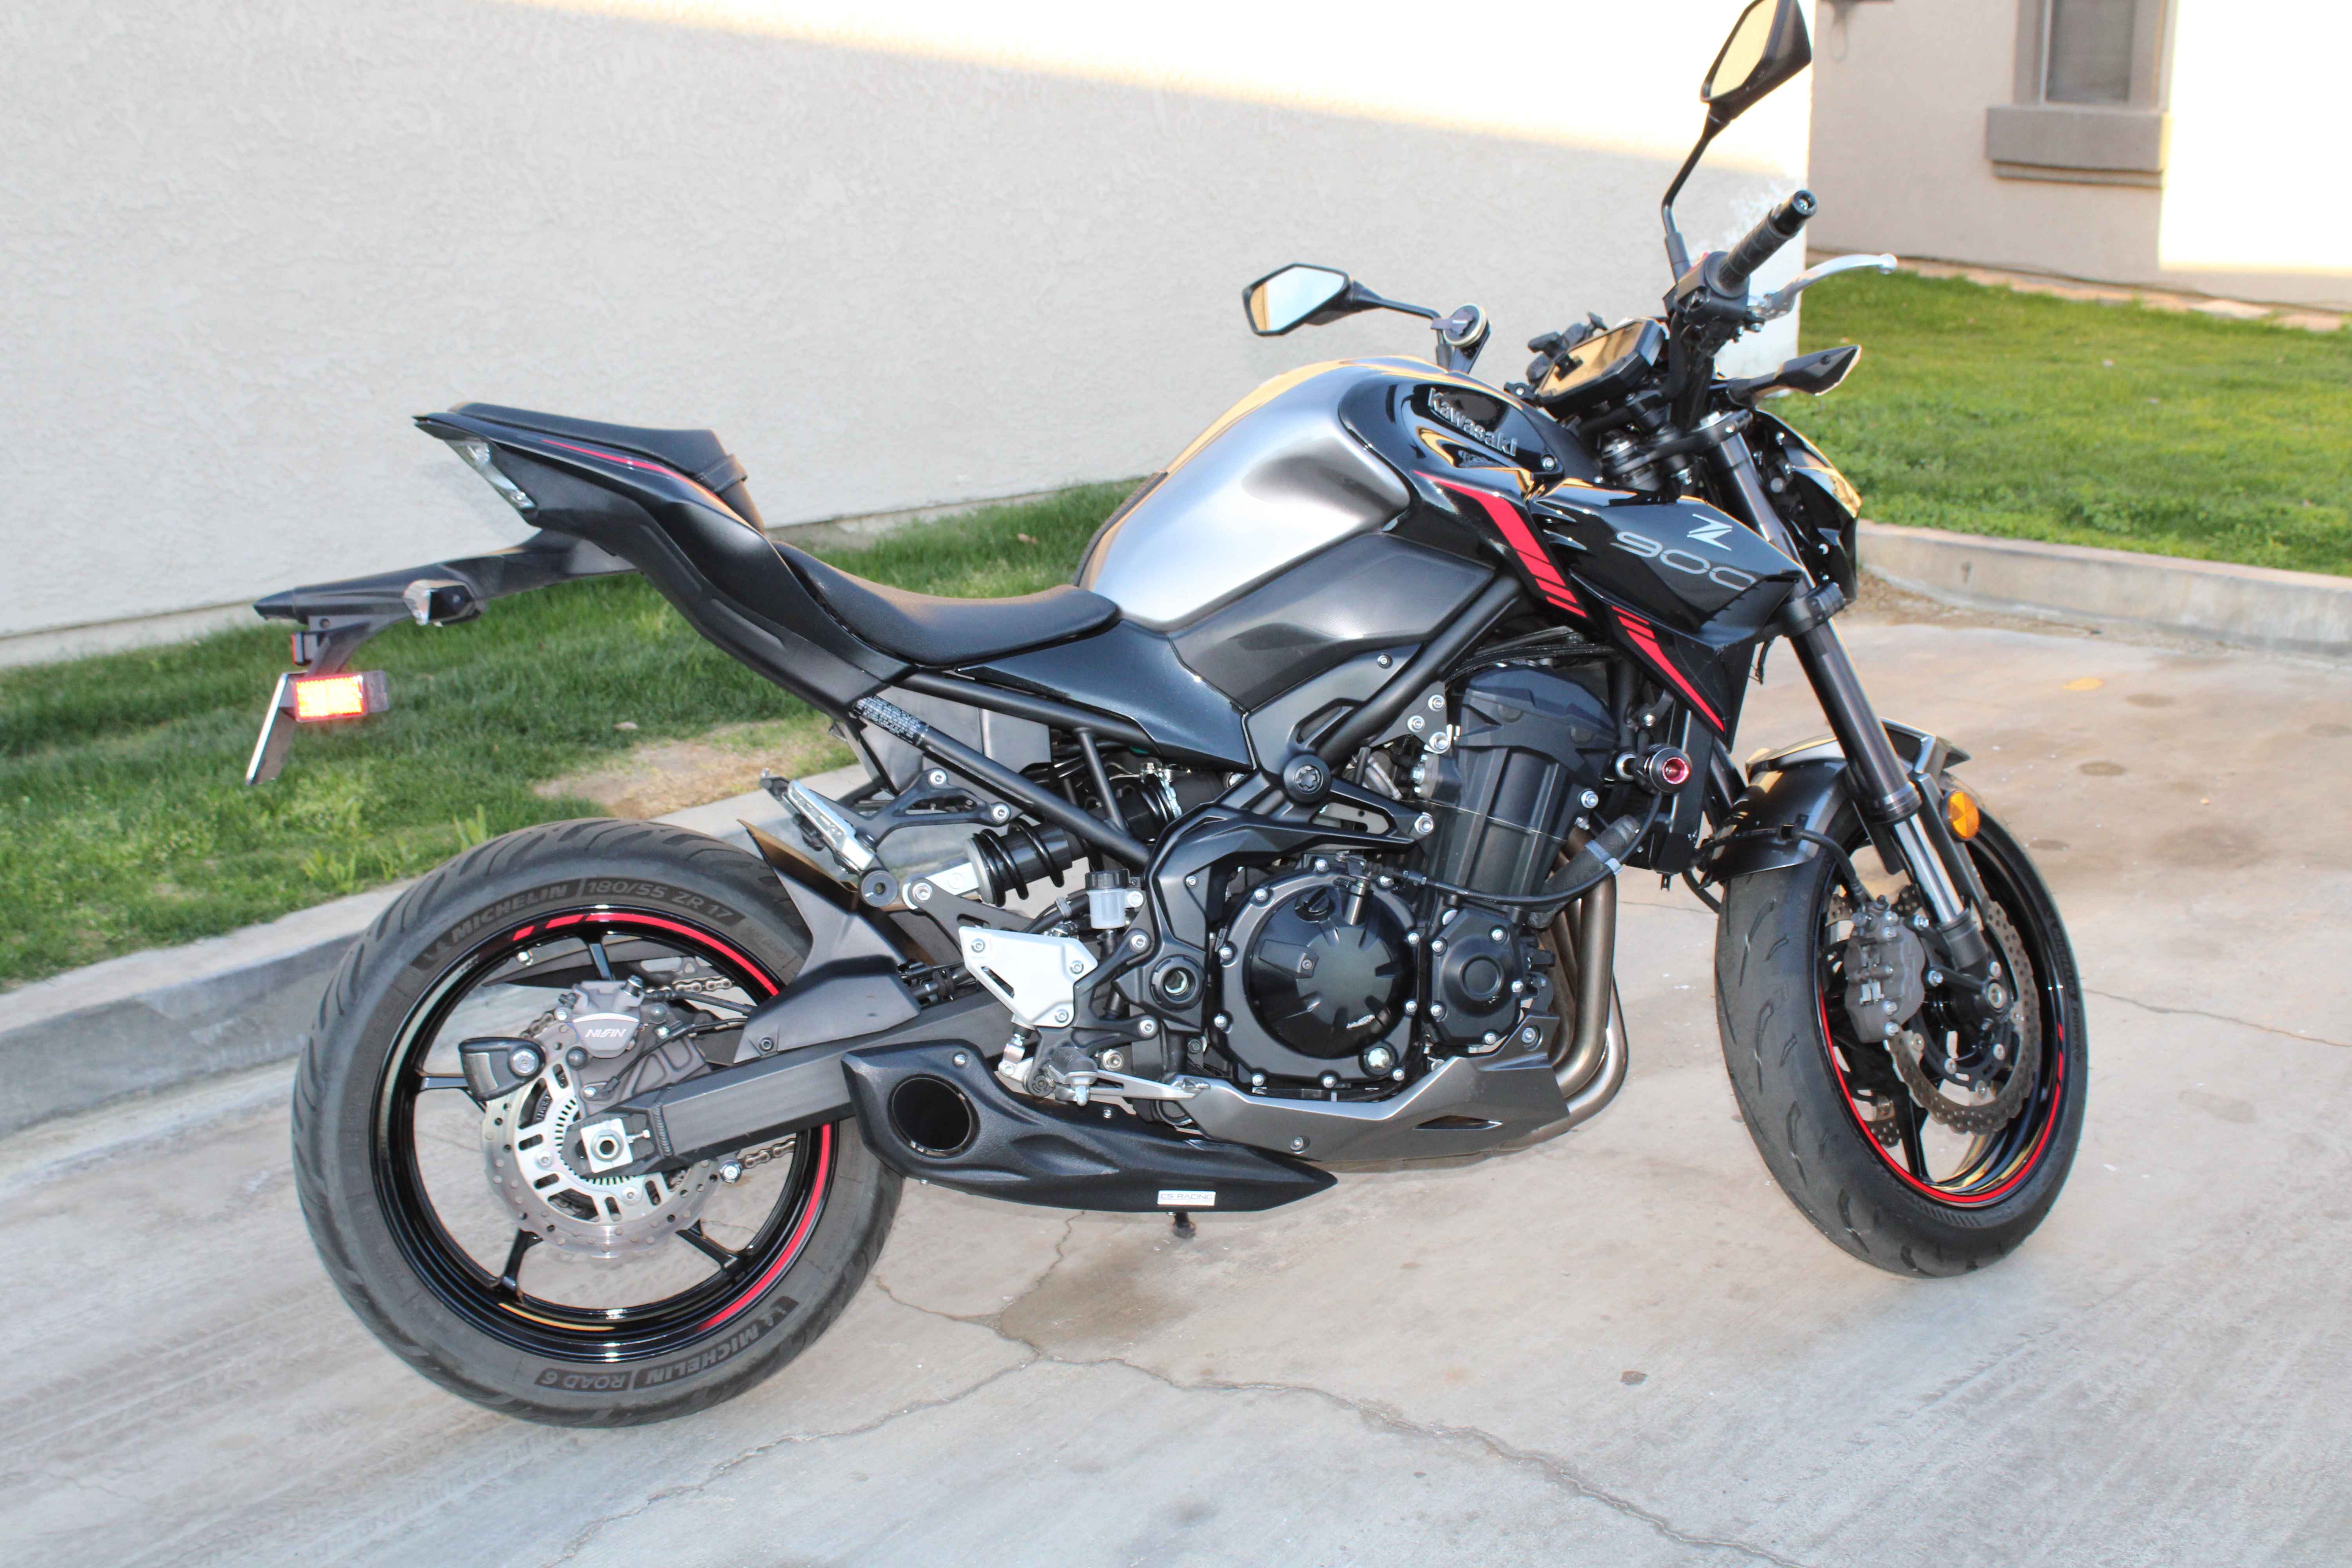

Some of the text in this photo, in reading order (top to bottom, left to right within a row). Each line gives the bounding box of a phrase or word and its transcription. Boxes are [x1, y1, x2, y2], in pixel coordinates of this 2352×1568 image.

[1428, 388, 1517, 457] Kawasaki
[1610, 532, 1756, 591] 900
[1687, 513, 1733, 551] Z
[452, 880, 734, 942] MICHELIN 180/55 ZR 17
[585, 1029, 627, 1038] NISSIN
[541, 1324, 760, 1389] MICHELIN ROAD 6
